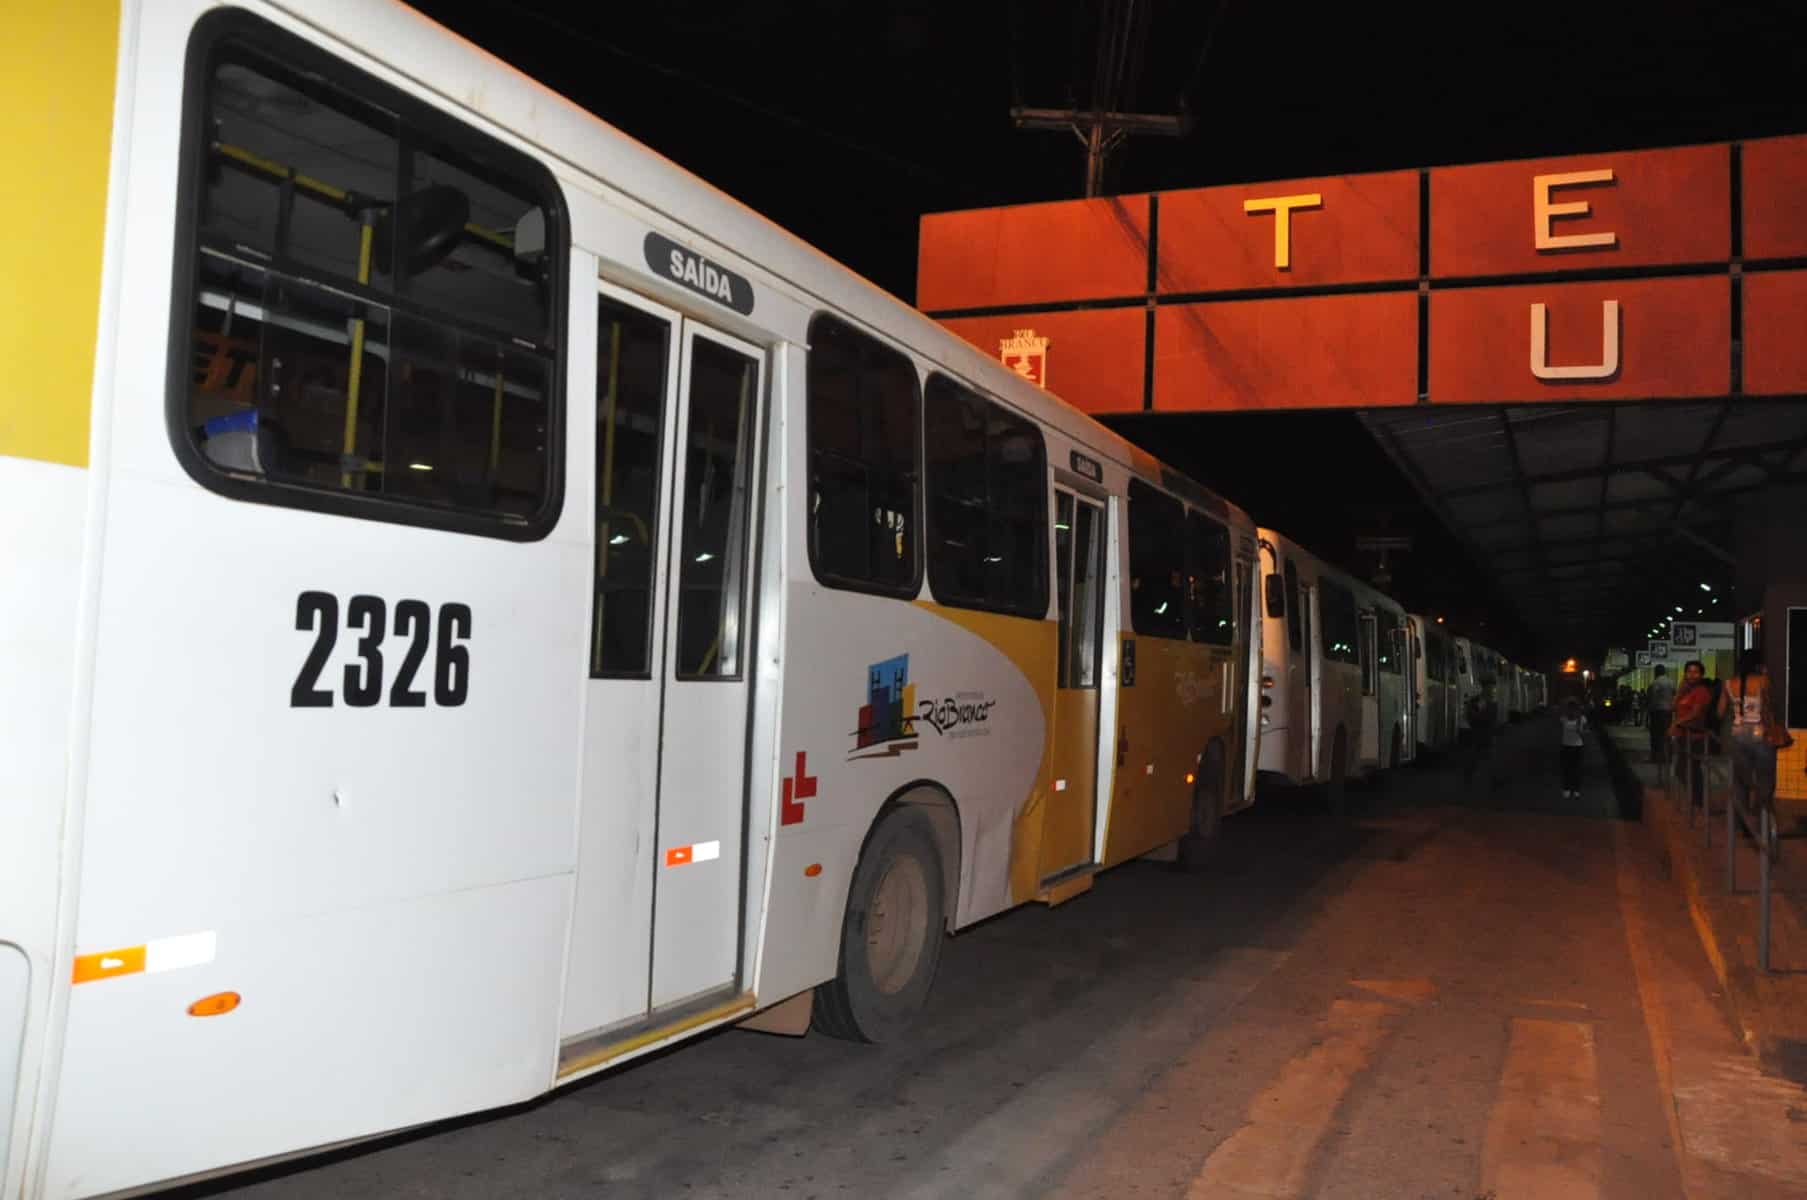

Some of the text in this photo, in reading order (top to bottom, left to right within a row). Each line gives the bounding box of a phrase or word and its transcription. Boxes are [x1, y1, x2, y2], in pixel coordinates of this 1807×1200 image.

[670, 249, 733, 303] SAÍDA
[1530, 300, 1619, 379] U
[290, 590, 472, 707] 2326
